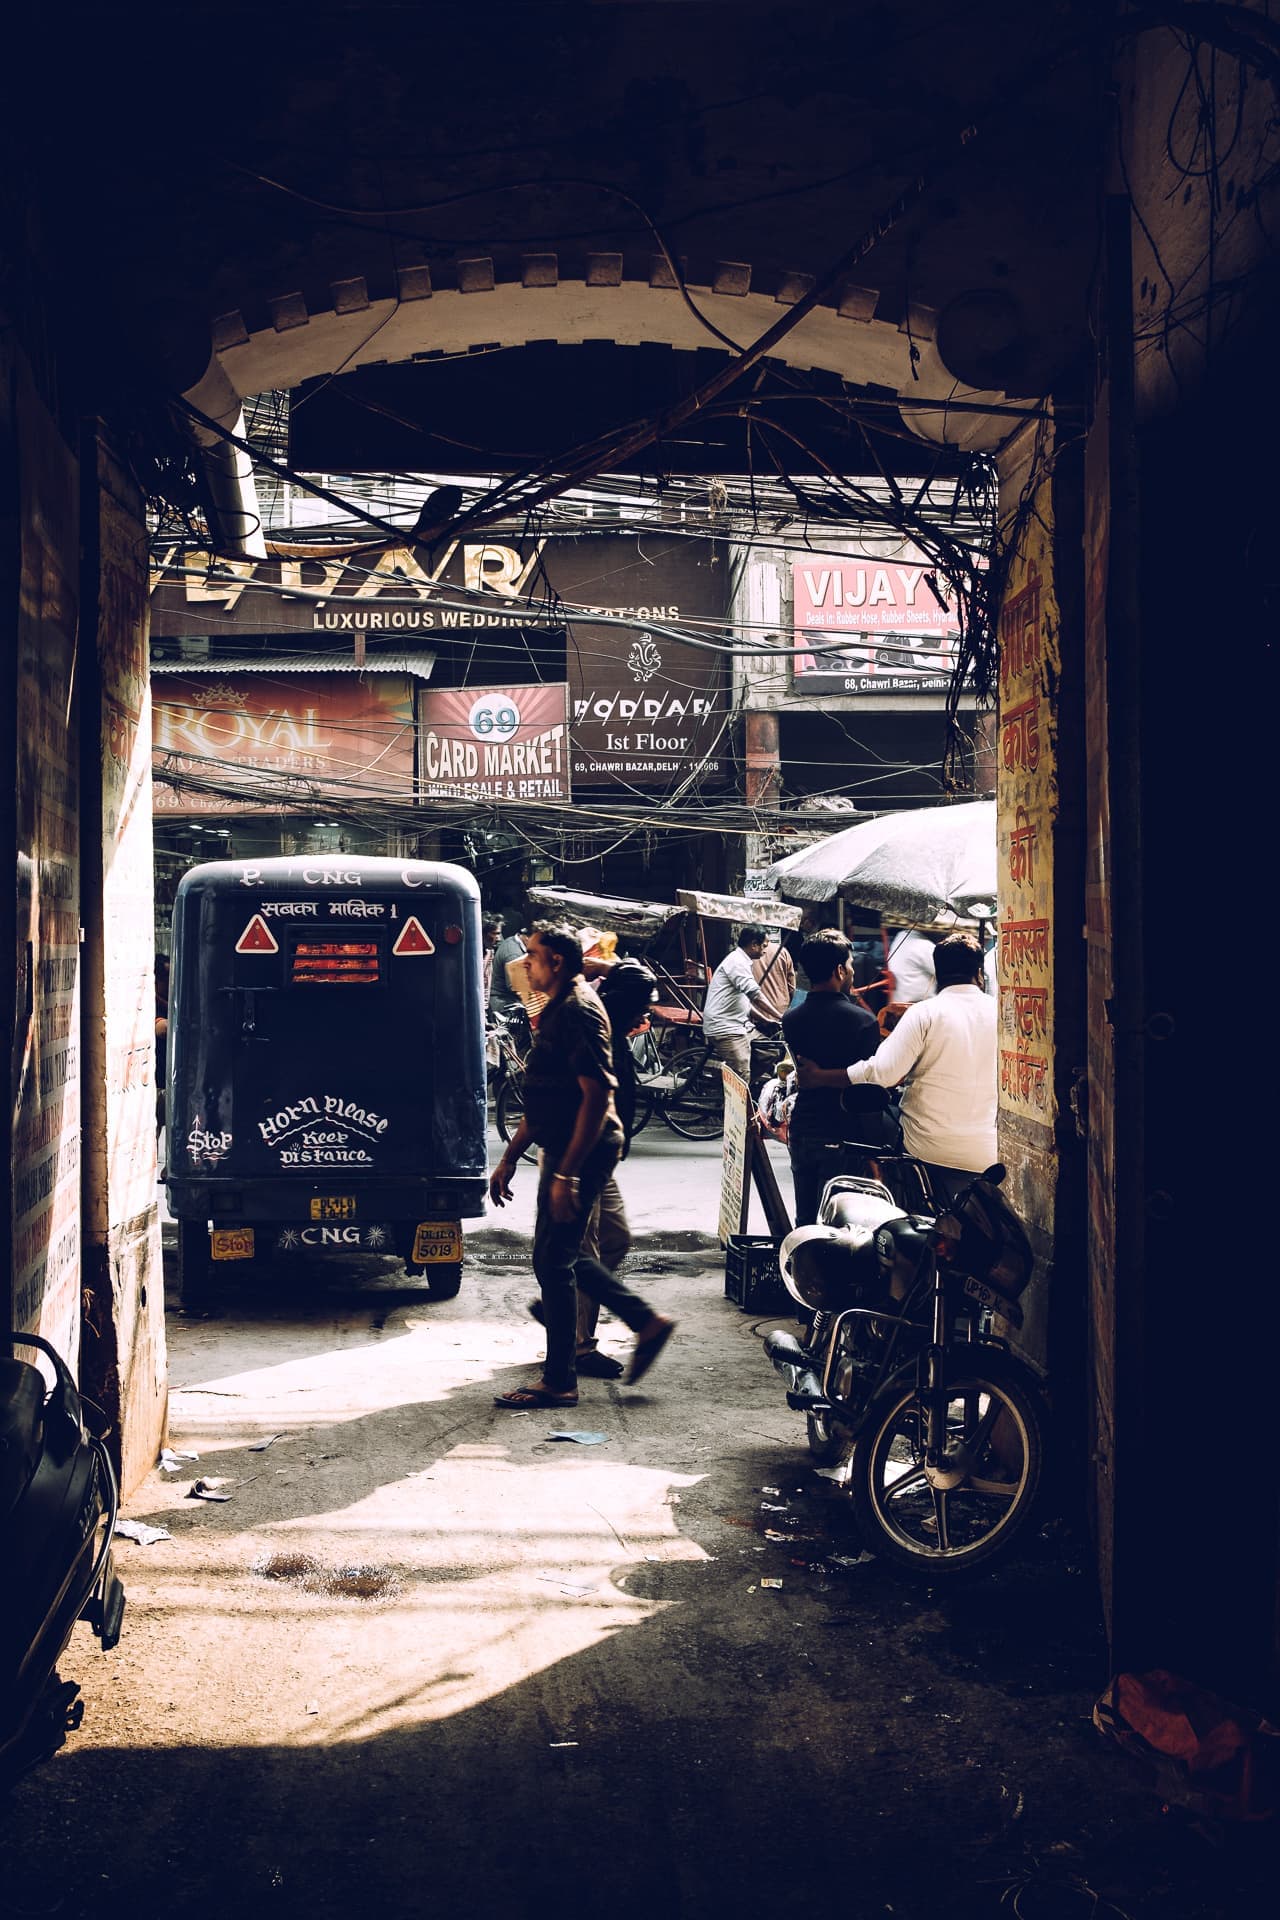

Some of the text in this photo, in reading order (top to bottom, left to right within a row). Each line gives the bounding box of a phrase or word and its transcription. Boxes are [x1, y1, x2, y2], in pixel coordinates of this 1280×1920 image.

[803, 569, 924, 607] VIJAY
[313, 612, 434, 629] LUXURIOUS
[806, 612, 824, 624] Deals
[836, 611, 860, 624] Rubber
[881, 609, 905, 624] Rubber
[860, 678, 891, 689] Chawri
[157, 702, 334, 757] ROYAL
[474, 708, 516, 734] 69
[426, 724, 564, 778] CARD MARKET
[634, 733, 688, 750] Floor
[574, 762, 588, 773] 69,
[590, 762, 623, 771] CHAWRI
[428, 778, 564, 800] WHOLESALE & RETAIL
[1009, 805, 1037, 889] की
[302, 868, 362, 886] CNG
[260, 902, 319, 918] सबका
[328, 899, 385, 918] मालिक
[301, 1226, 361, 1245] CNG
